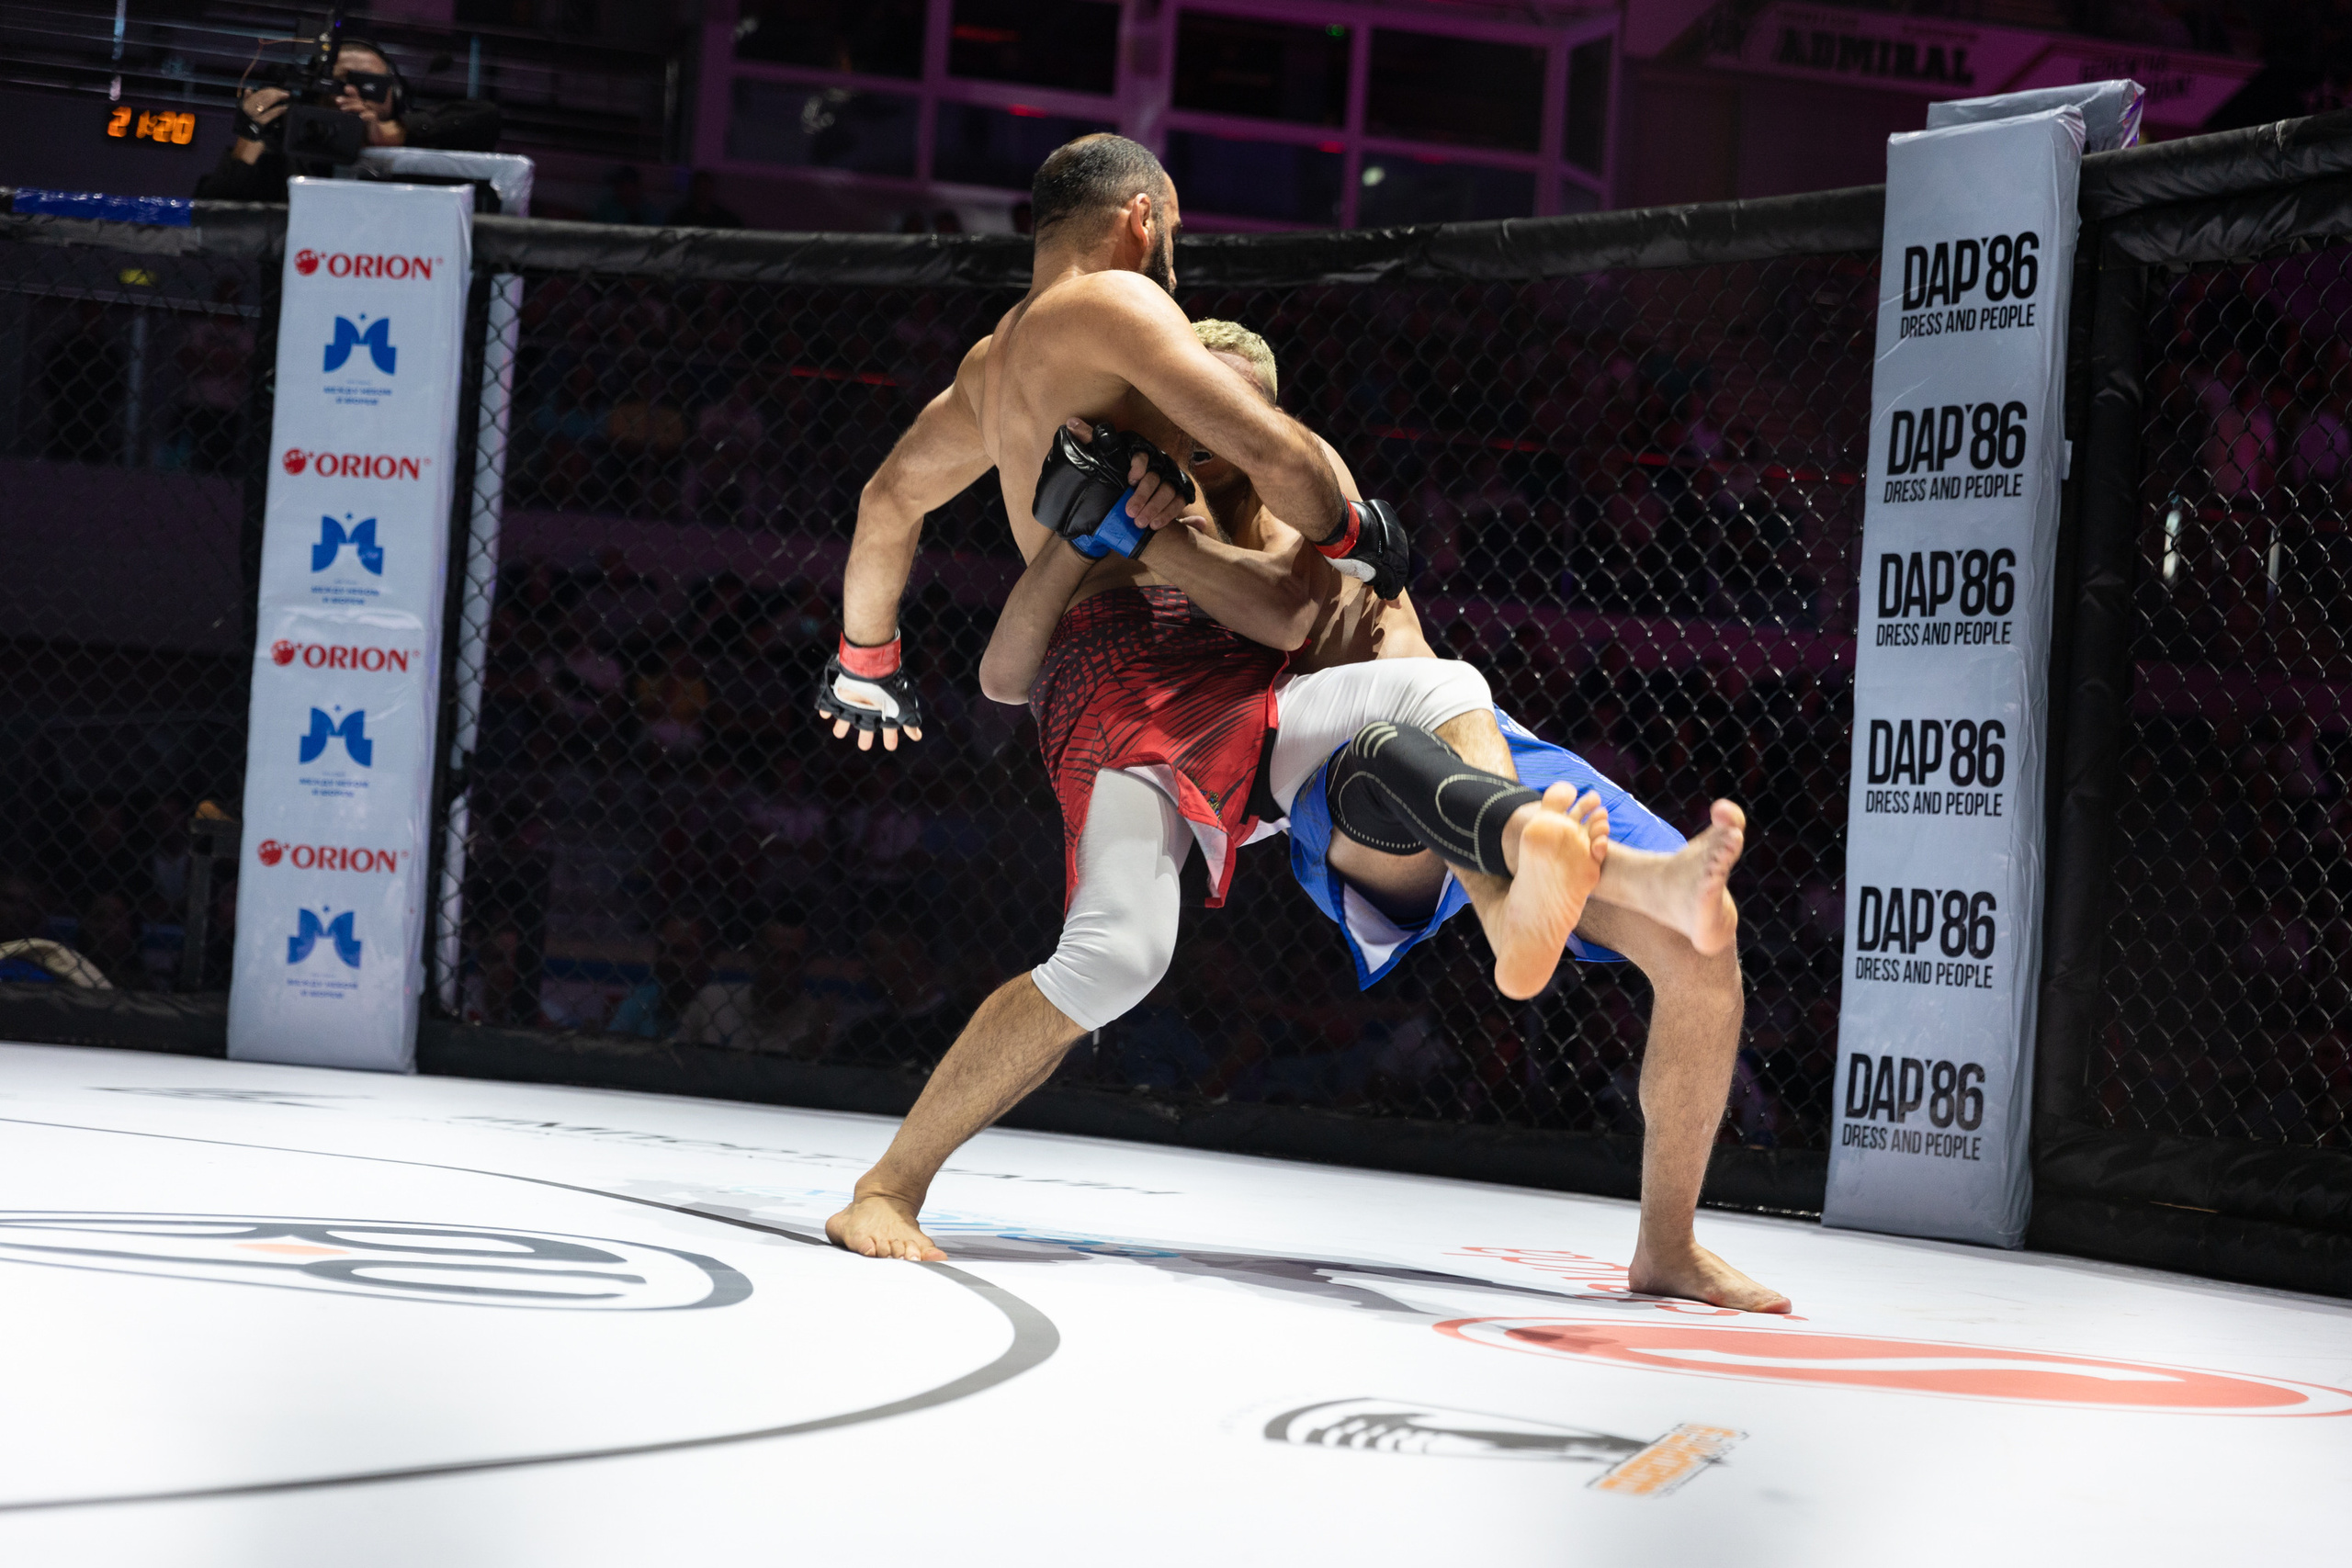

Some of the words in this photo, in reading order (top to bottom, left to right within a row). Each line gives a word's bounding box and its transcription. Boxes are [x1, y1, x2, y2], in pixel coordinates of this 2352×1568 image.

[327, 253, 433, 281] ORION
[1902, 231, 2040, 311] DAP'86
[1899, 311, 1943, 340] DRESS
[1945, 309, 1977, 333] AND
[1980, 303, 2037, 331] PEOPLE
[1886, 400, 2028, 476] DAP'86
[314, 452, 421, 481] ORION
[1883, 479, 1927, 503] DRESS
[1929, 477, 1962, 501] AND
[1964, 474, 2024, 499] PEOPLE
[1877, 548, 2017, 619] DAP'86
[1876, 623, 1919, 647] DRESS
[1921, 622, 1951, 646] AND
[1953, 621, 2013, 646] PEOPLE
[302, 643, 409, 673] ORION
[1867, 719, 2007, 788] DAP'86
[1865, 791, 1910, 814] DRESS
[1912, 791, 1942, 815] AND
[1945, 792, 2004, 817] PEOPLE
[290, 844, 398, 874] ORION
[1856, 886, 1997, 960] DAP'86
[1855, 957, 1899, 982] DRESS
[1902, 960, 1932, 985] AND
[1935, 963, 1994, 989] PEOPLE
[1844, 1053, 1986, 1132] DAP'86
[1841, 1123, 1888, 1150] DRESS
[1891, 1129, 1922, 1154] AND
[1925, 1133, 1982, 1161] PEOPLE
